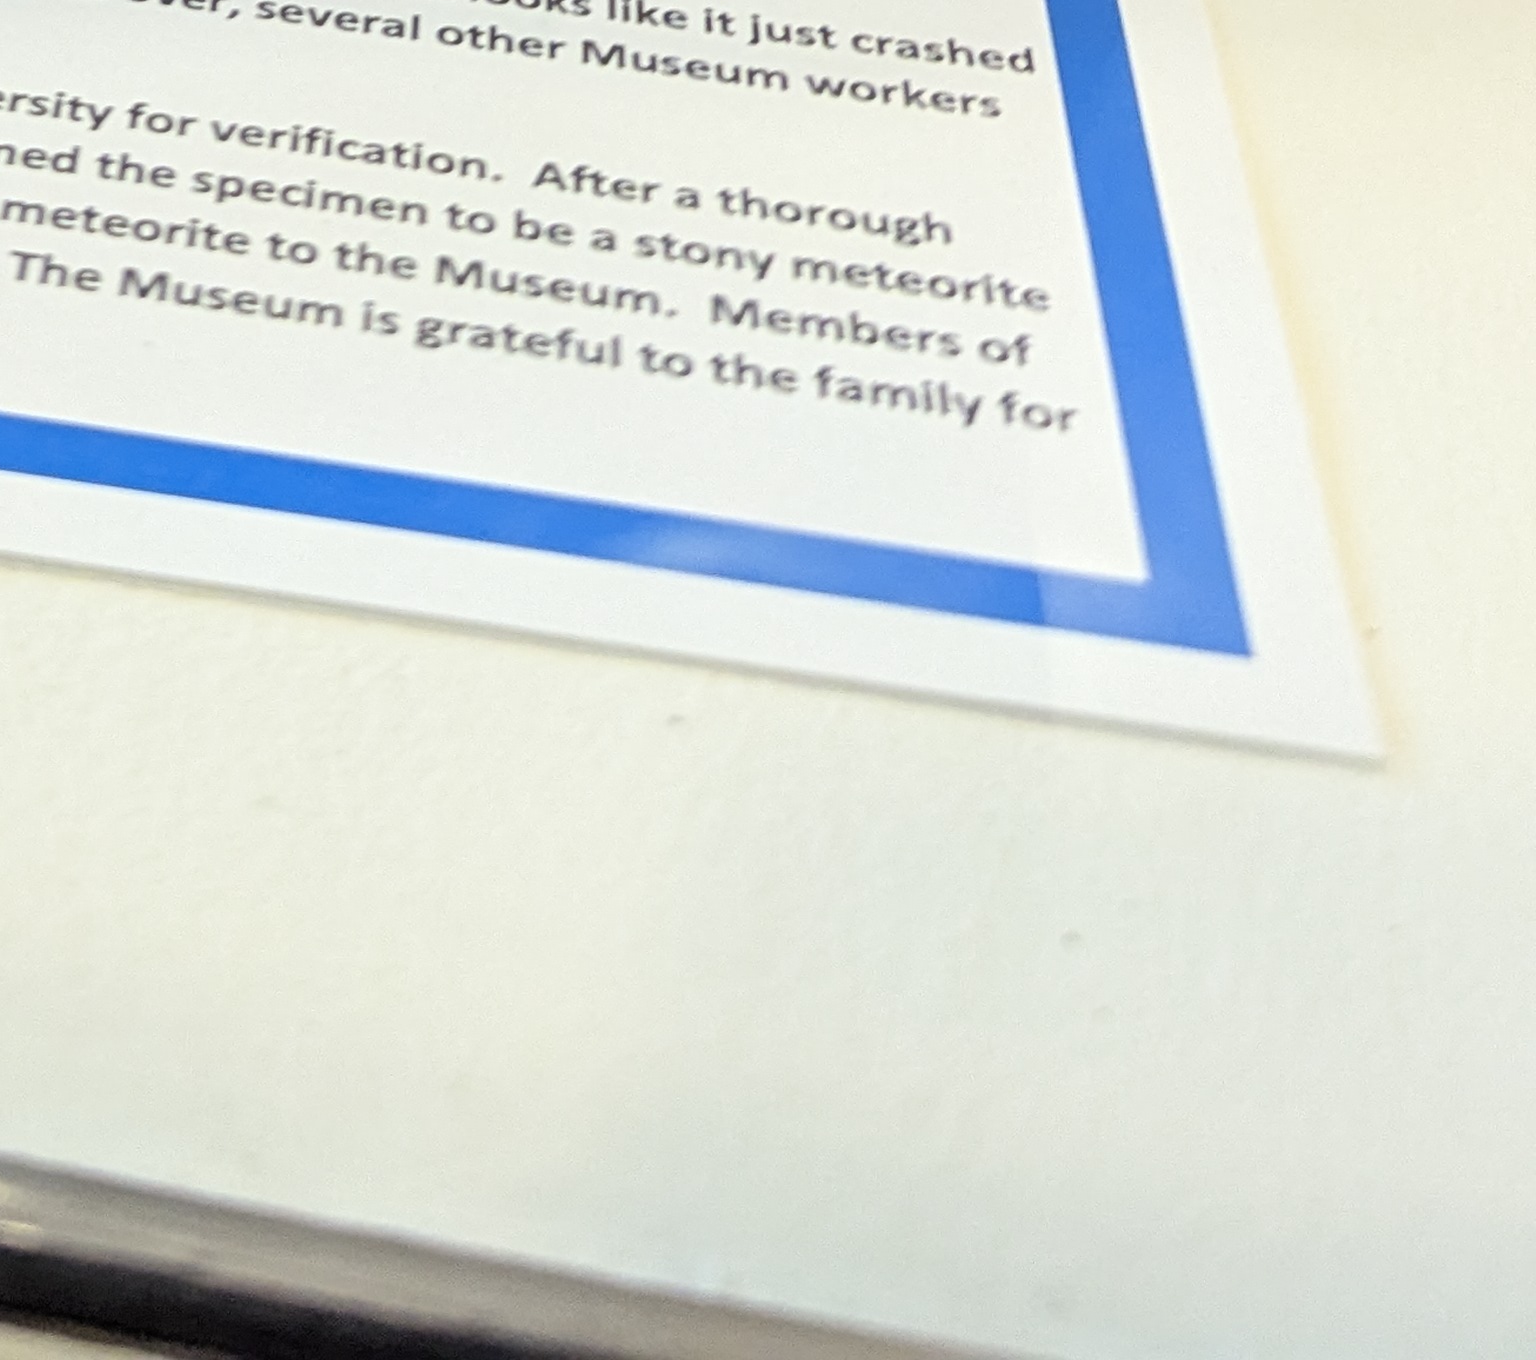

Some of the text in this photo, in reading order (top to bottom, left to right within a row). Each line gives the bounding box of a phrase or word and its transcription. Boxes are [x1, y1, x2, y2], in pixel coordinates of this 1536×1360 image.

[255, 0, 421, 41] several
[435, 23, 567, 60] other
[580, 38, 789, 91] Museum
[804, 74, 1001, 118] workers
[746, 12, 836, 50] just
[850, 33, 1036, 74] crashed
[192, 170, 427, 225] specimen
[635, 233, 774, 281] stony
[792, 257, 1048, 310] meteorite
[210, 120, 502, 182] verification.
[531, 161, 660, 203] After
[716, 187, 952, 247] thorough
[0, 199, 250, 256] meteorite
[434, 254, 676, 317] Museum.
[711, 292, 960, 357] Members
[118, 267, 343, 327] Museum
[414, 317, 620, 368] grateful
[813, 365, 982, 427] family
